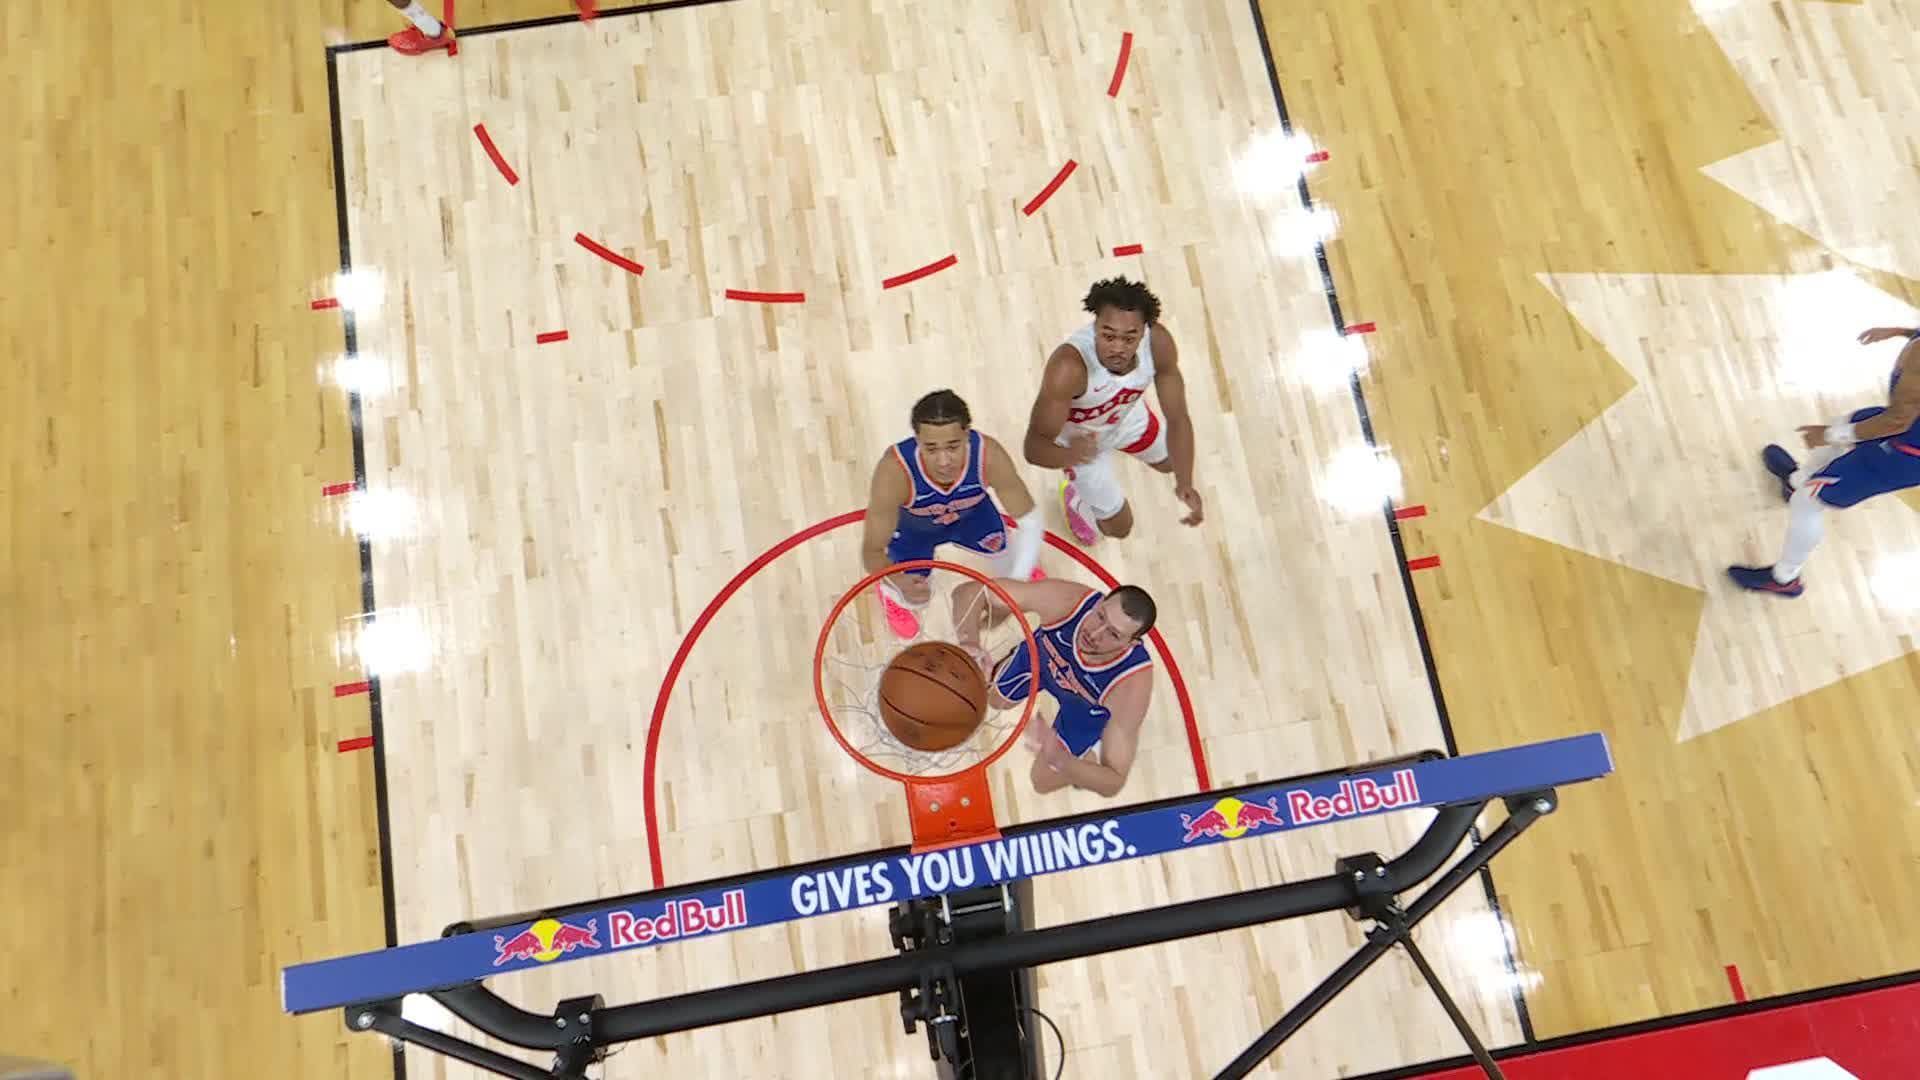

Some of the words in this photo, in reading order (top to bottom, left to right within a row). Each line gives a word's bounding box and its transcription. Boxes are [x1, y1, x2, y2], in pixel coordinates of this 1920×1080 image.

[1287, 780, 1355, 825] Red
[1353, 768, 1420, 812] Bull
[791, 861, 893, 915] GIVES
[899, 846, 976, 896] YOU
[981, 819, 1137, 881] WIIINGS.
[609, 901, 679, 948] Red
[679, 889, 747, 937] Bull
